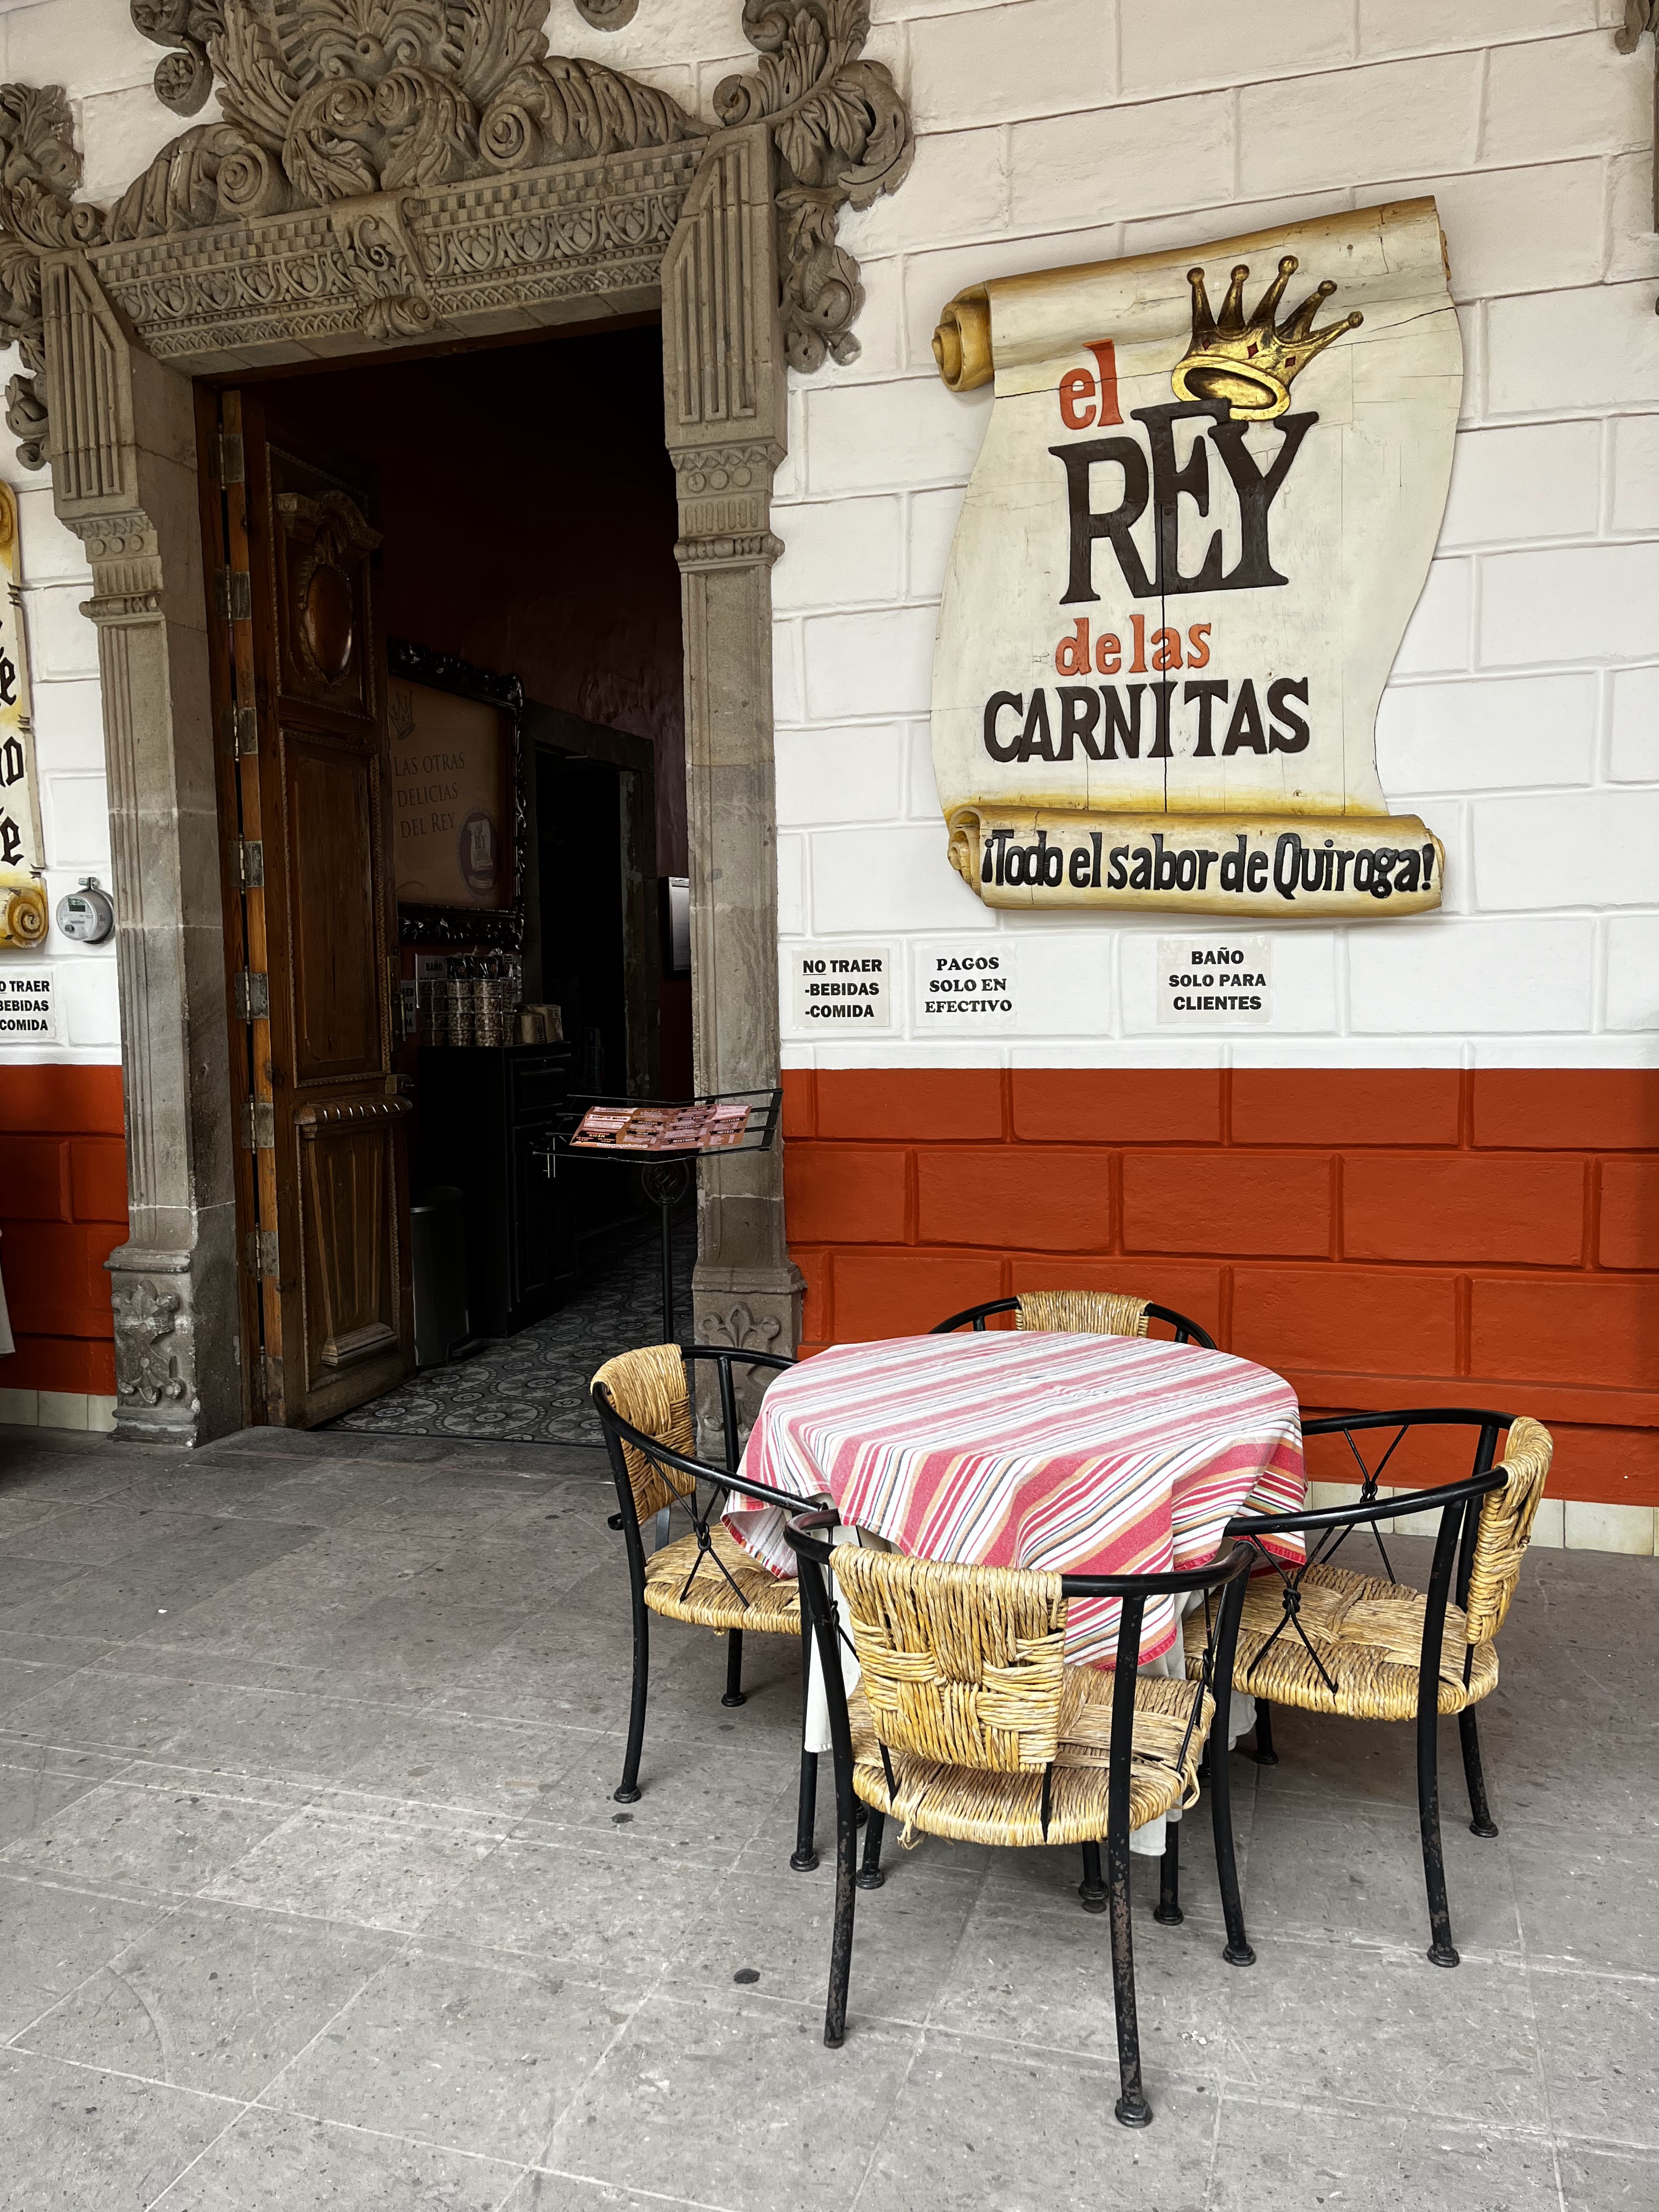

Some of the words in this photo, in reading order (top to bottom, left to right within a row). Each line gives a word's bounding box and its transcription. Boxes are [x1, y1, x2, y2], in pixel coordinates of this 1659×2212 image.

[1058, 338, 1124, 430] el
[1048, 397, 1319, 605] REY
[1056, 618, 1121, 676] de
[1129, 614, 1212, 673] las
[984, 676, 1310, 763] CARNITAS
[422, 752, 465, 775] OTRAS
[396, 782, 458, 808] DELICIAS
[399, 816, 427, 839] DEL
[981, 829, 1059, 888] ¡Todo
[1069, 832, 1102, 888] el
[1107, 833, 1219, 891] sabor
[1220, 834, 1268, 893] de
[1273, 832, 1435, 900] Quiroga!
[1191, 947, 1244, 965] BAÑO
[426, 960, 443, 972] BAÑO
[803, 959, 827, 973] NO
[830, 959, 882, 972] TRAER
[936, 957, 999, 971] PAGOS
[0, 980, 6, 992] O
[9, 980, 50, 992] TRAER
[929, 979, 977, 992] SOLO
[981, 978, 1007, 991] EN
[1169, 973, 1215, 988] SOLO
[1219, 973, 1266, 987] PARA
[805, 982, 879, 996] -BEBIDAS
[924, 1000, 1012, 1013] EFECTIVO
[1173, 996, 1262, 1011] CLIENTES
[805, 1005, 874, 1018] -COMIDA
